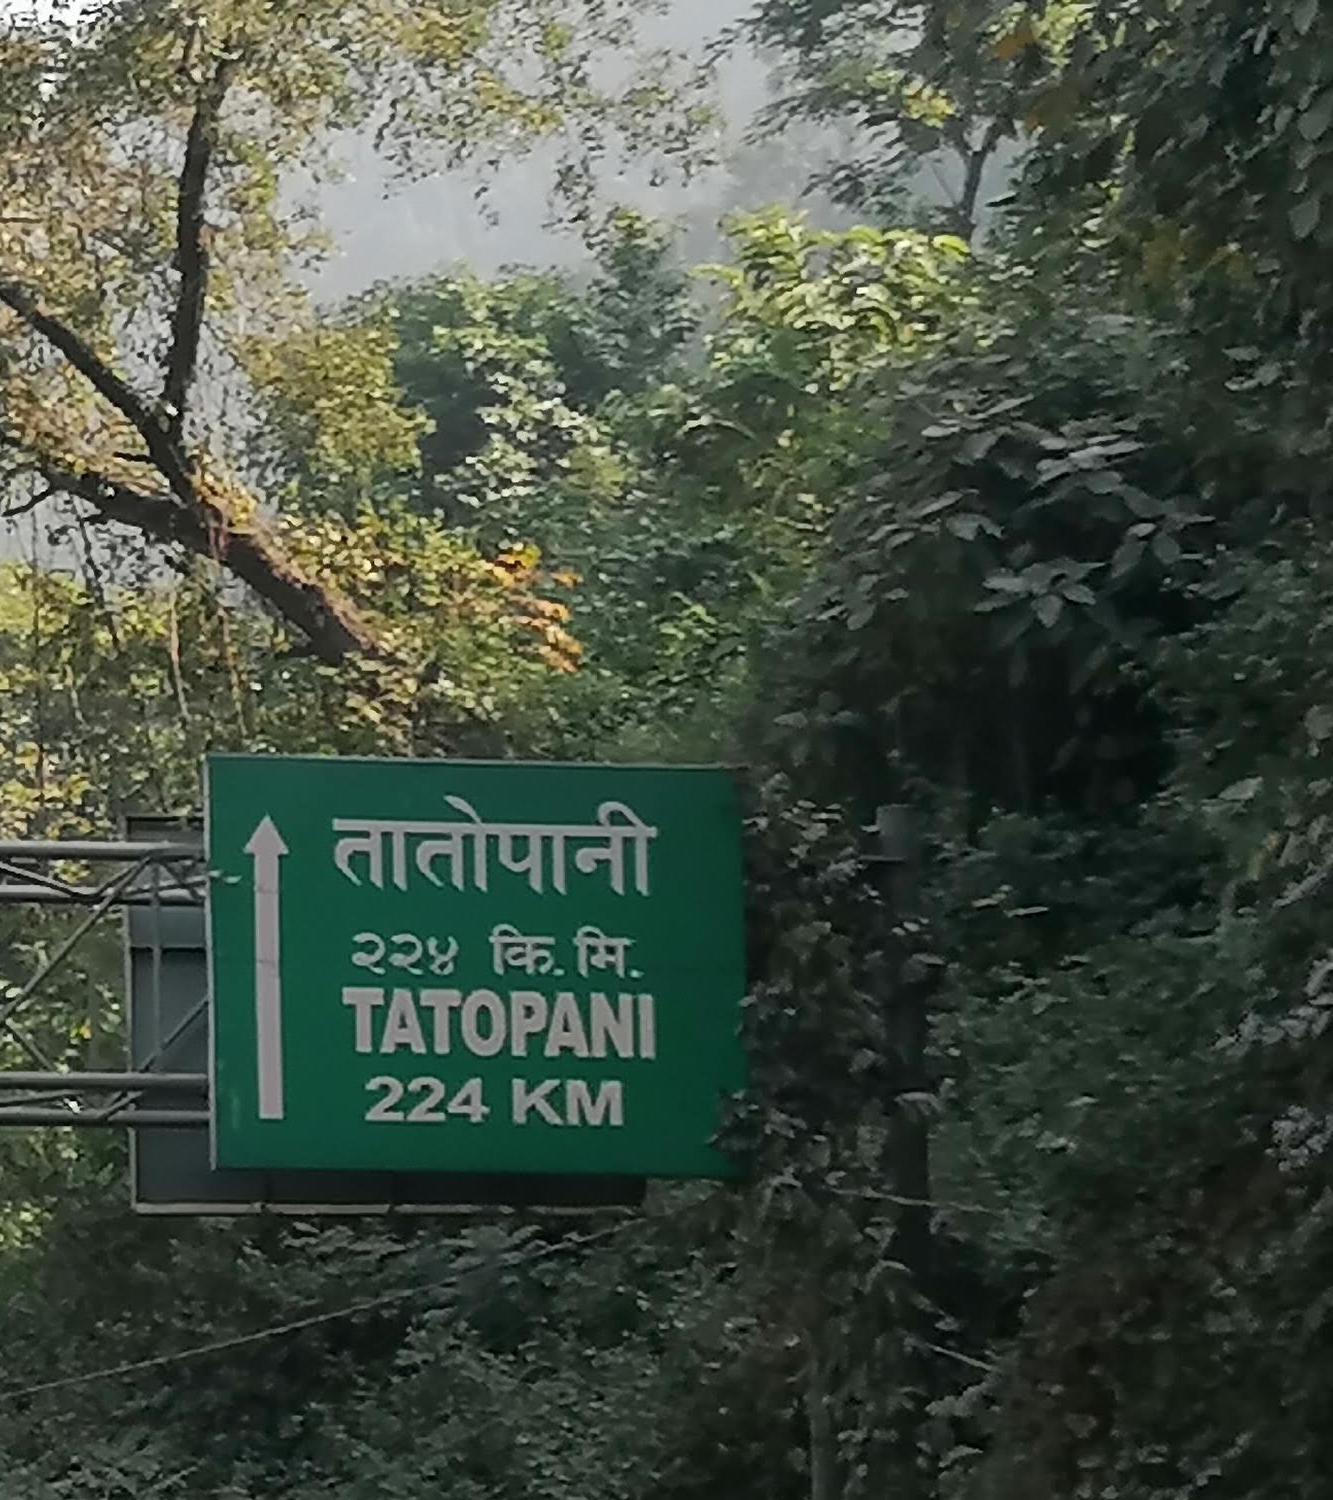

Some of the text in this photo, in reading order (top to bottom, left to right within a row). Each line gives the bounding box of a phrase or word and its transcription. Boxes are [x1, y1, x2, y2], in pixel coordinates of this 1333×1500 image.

[332, 795, 658, 897] तातोपानी
[351, 931, 460, 976] २२४
[342, 987, 656, 1060] TATOPANI
[364, 1076, 624, 1127] 224 KM
